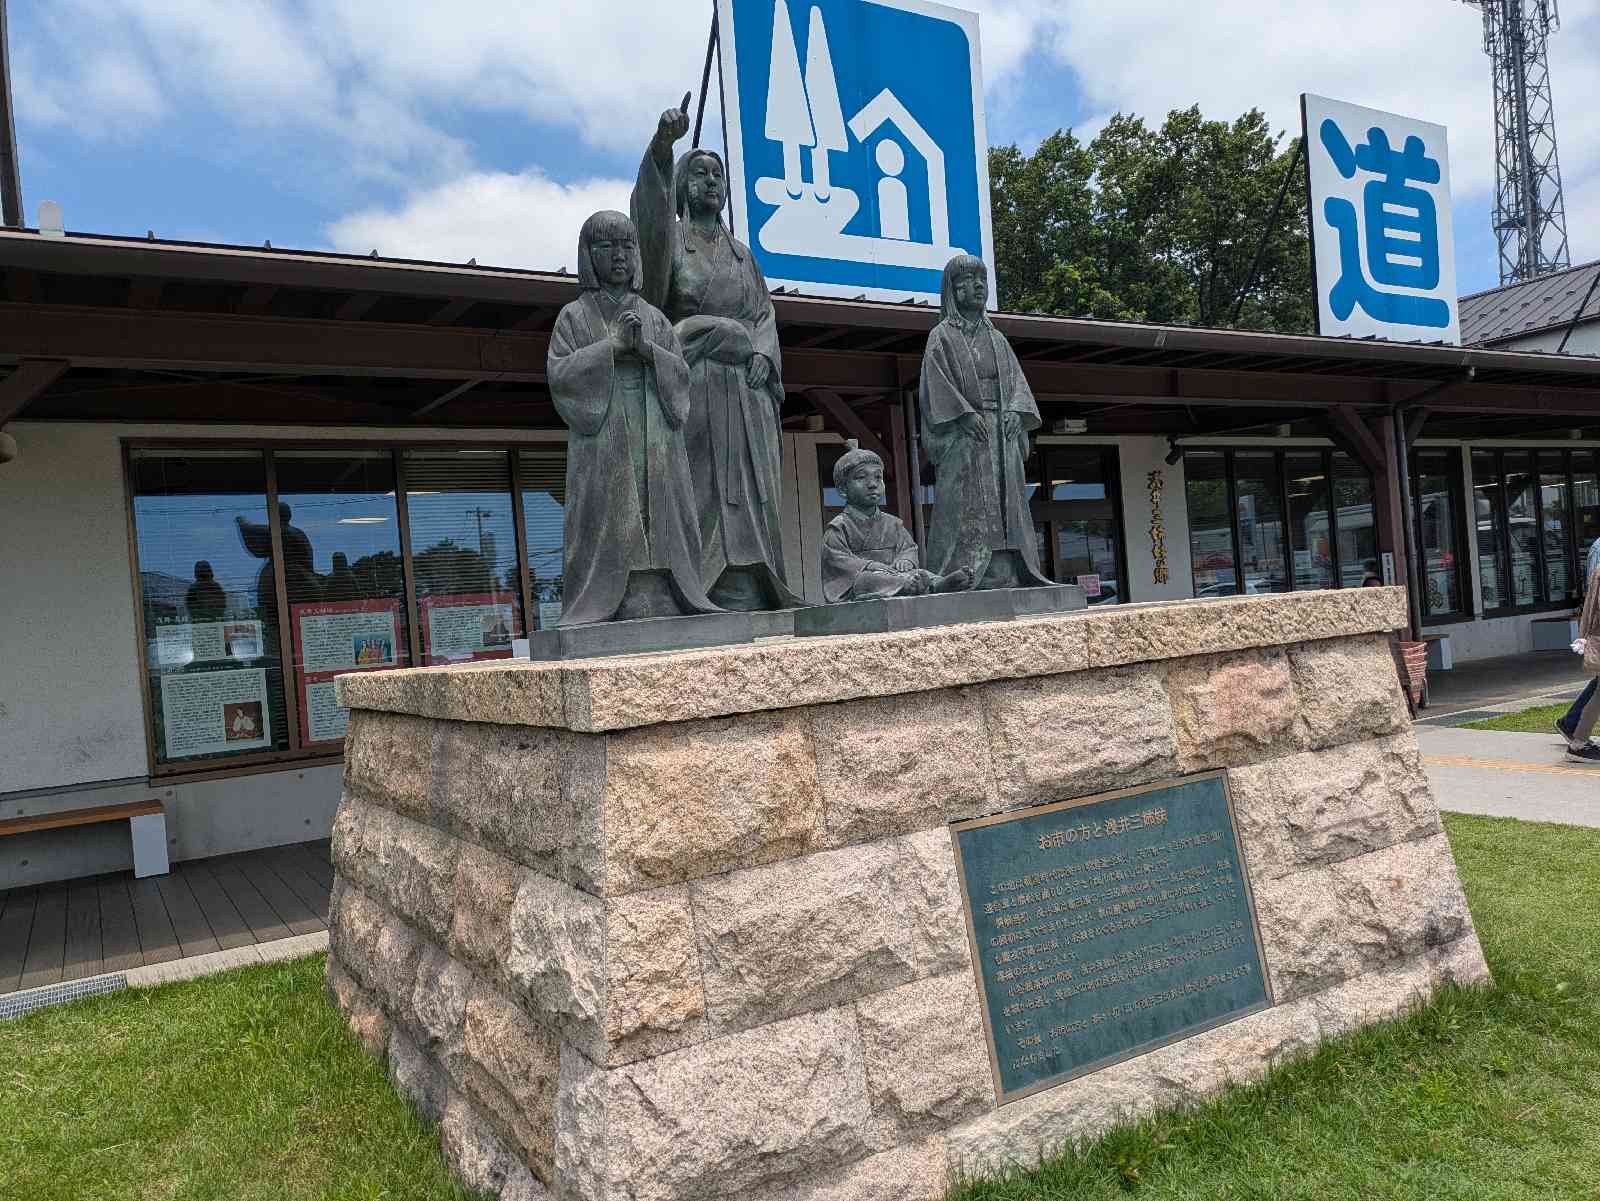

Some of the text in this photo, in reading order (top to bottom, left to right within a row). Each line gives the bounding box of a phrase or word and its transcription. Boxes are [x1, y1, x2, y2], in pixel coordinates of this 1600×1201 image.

[1319, 118, 1450, 329] 道
[1038, 807, 1168, 849] お市の方と浅井三姉妹
